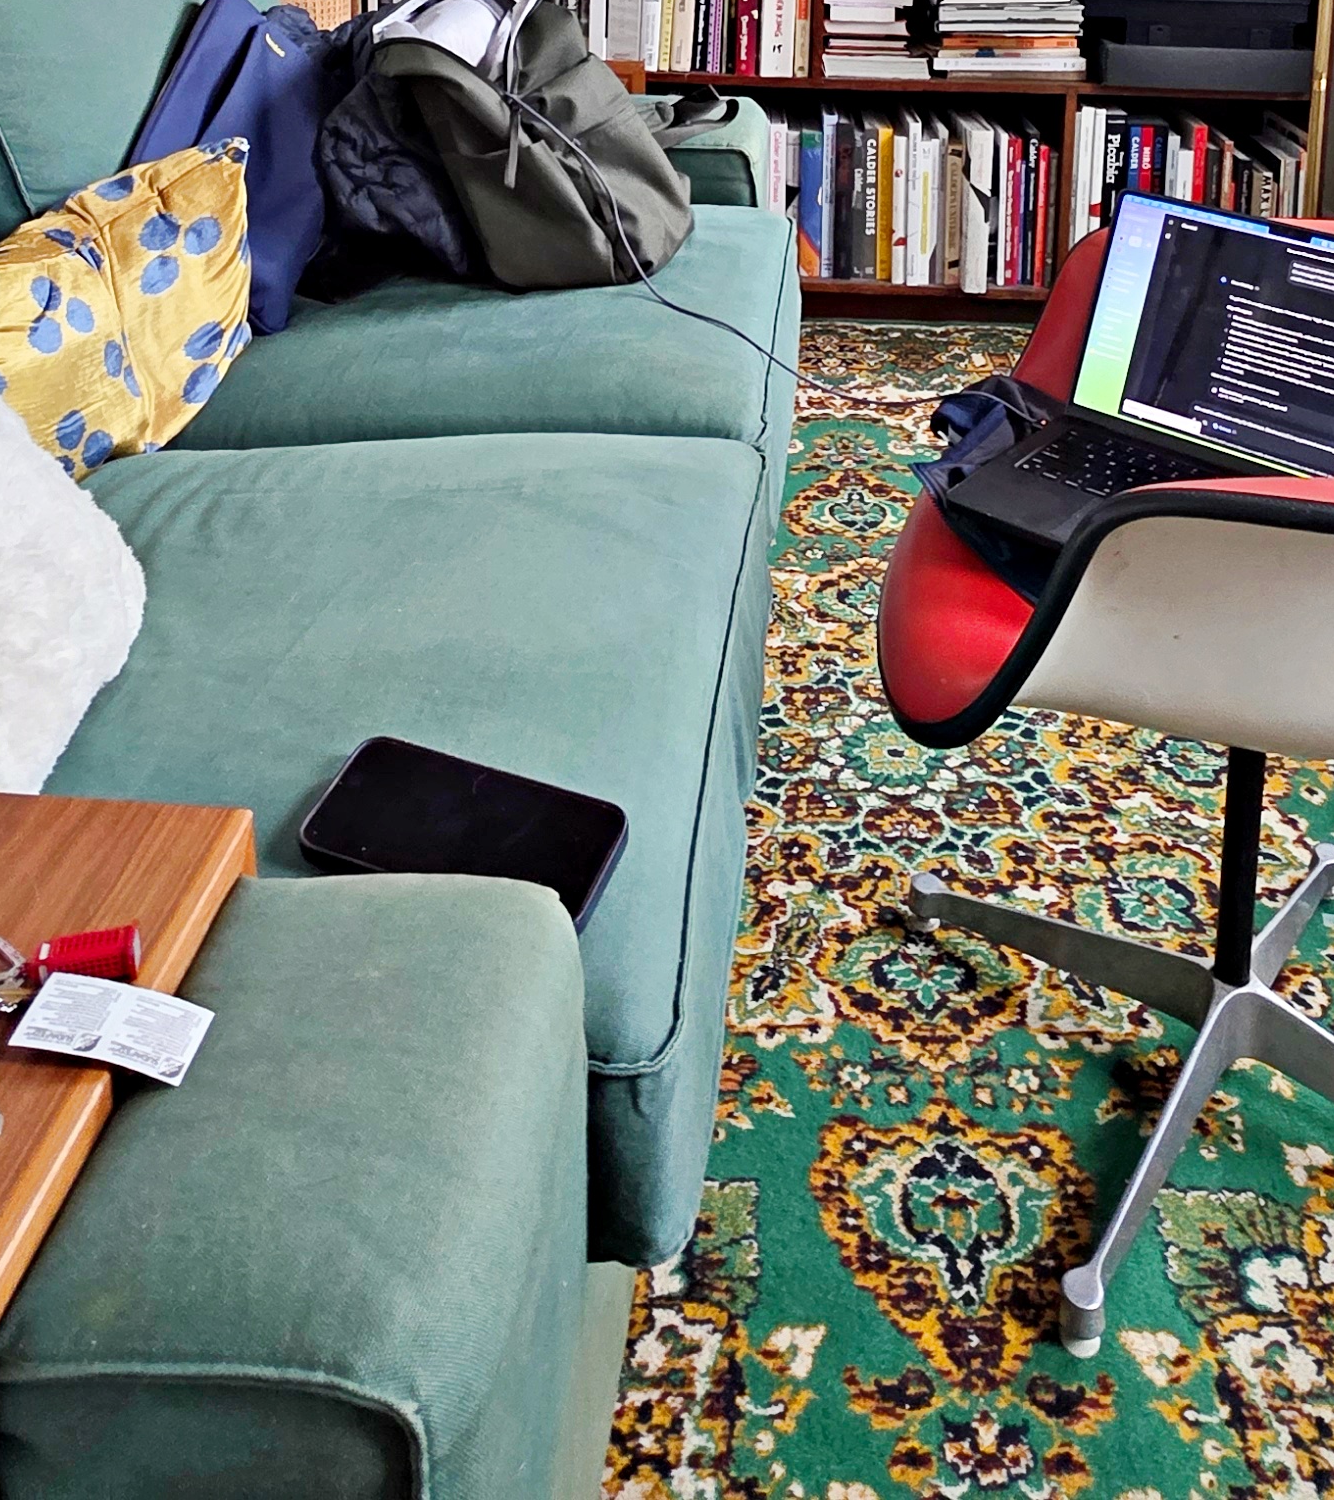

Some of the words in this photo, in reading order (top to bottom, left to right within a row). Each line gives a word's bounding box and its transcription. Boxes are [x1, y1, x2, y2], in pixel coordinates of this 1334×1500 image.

[774, 13, 784, 40] KING
[773, 130, 783, 157] Calder
[1028, 138, 1039, 168] Calder
[1130, 136, 1141, 170] CALDER
[773, 159, 782, 173] and
[865, 138, 877, 184] CALDER
[1106, 133, 1121, 183] Picabia
[1142, 146, 1153, 170] MIRÓ
[772, 175, 781, 204] Picasso
[853, 168, 864, 193] Calder
[1261, 175, 1272, 203] MAX
[864, 187, 876, 236] STORIES
